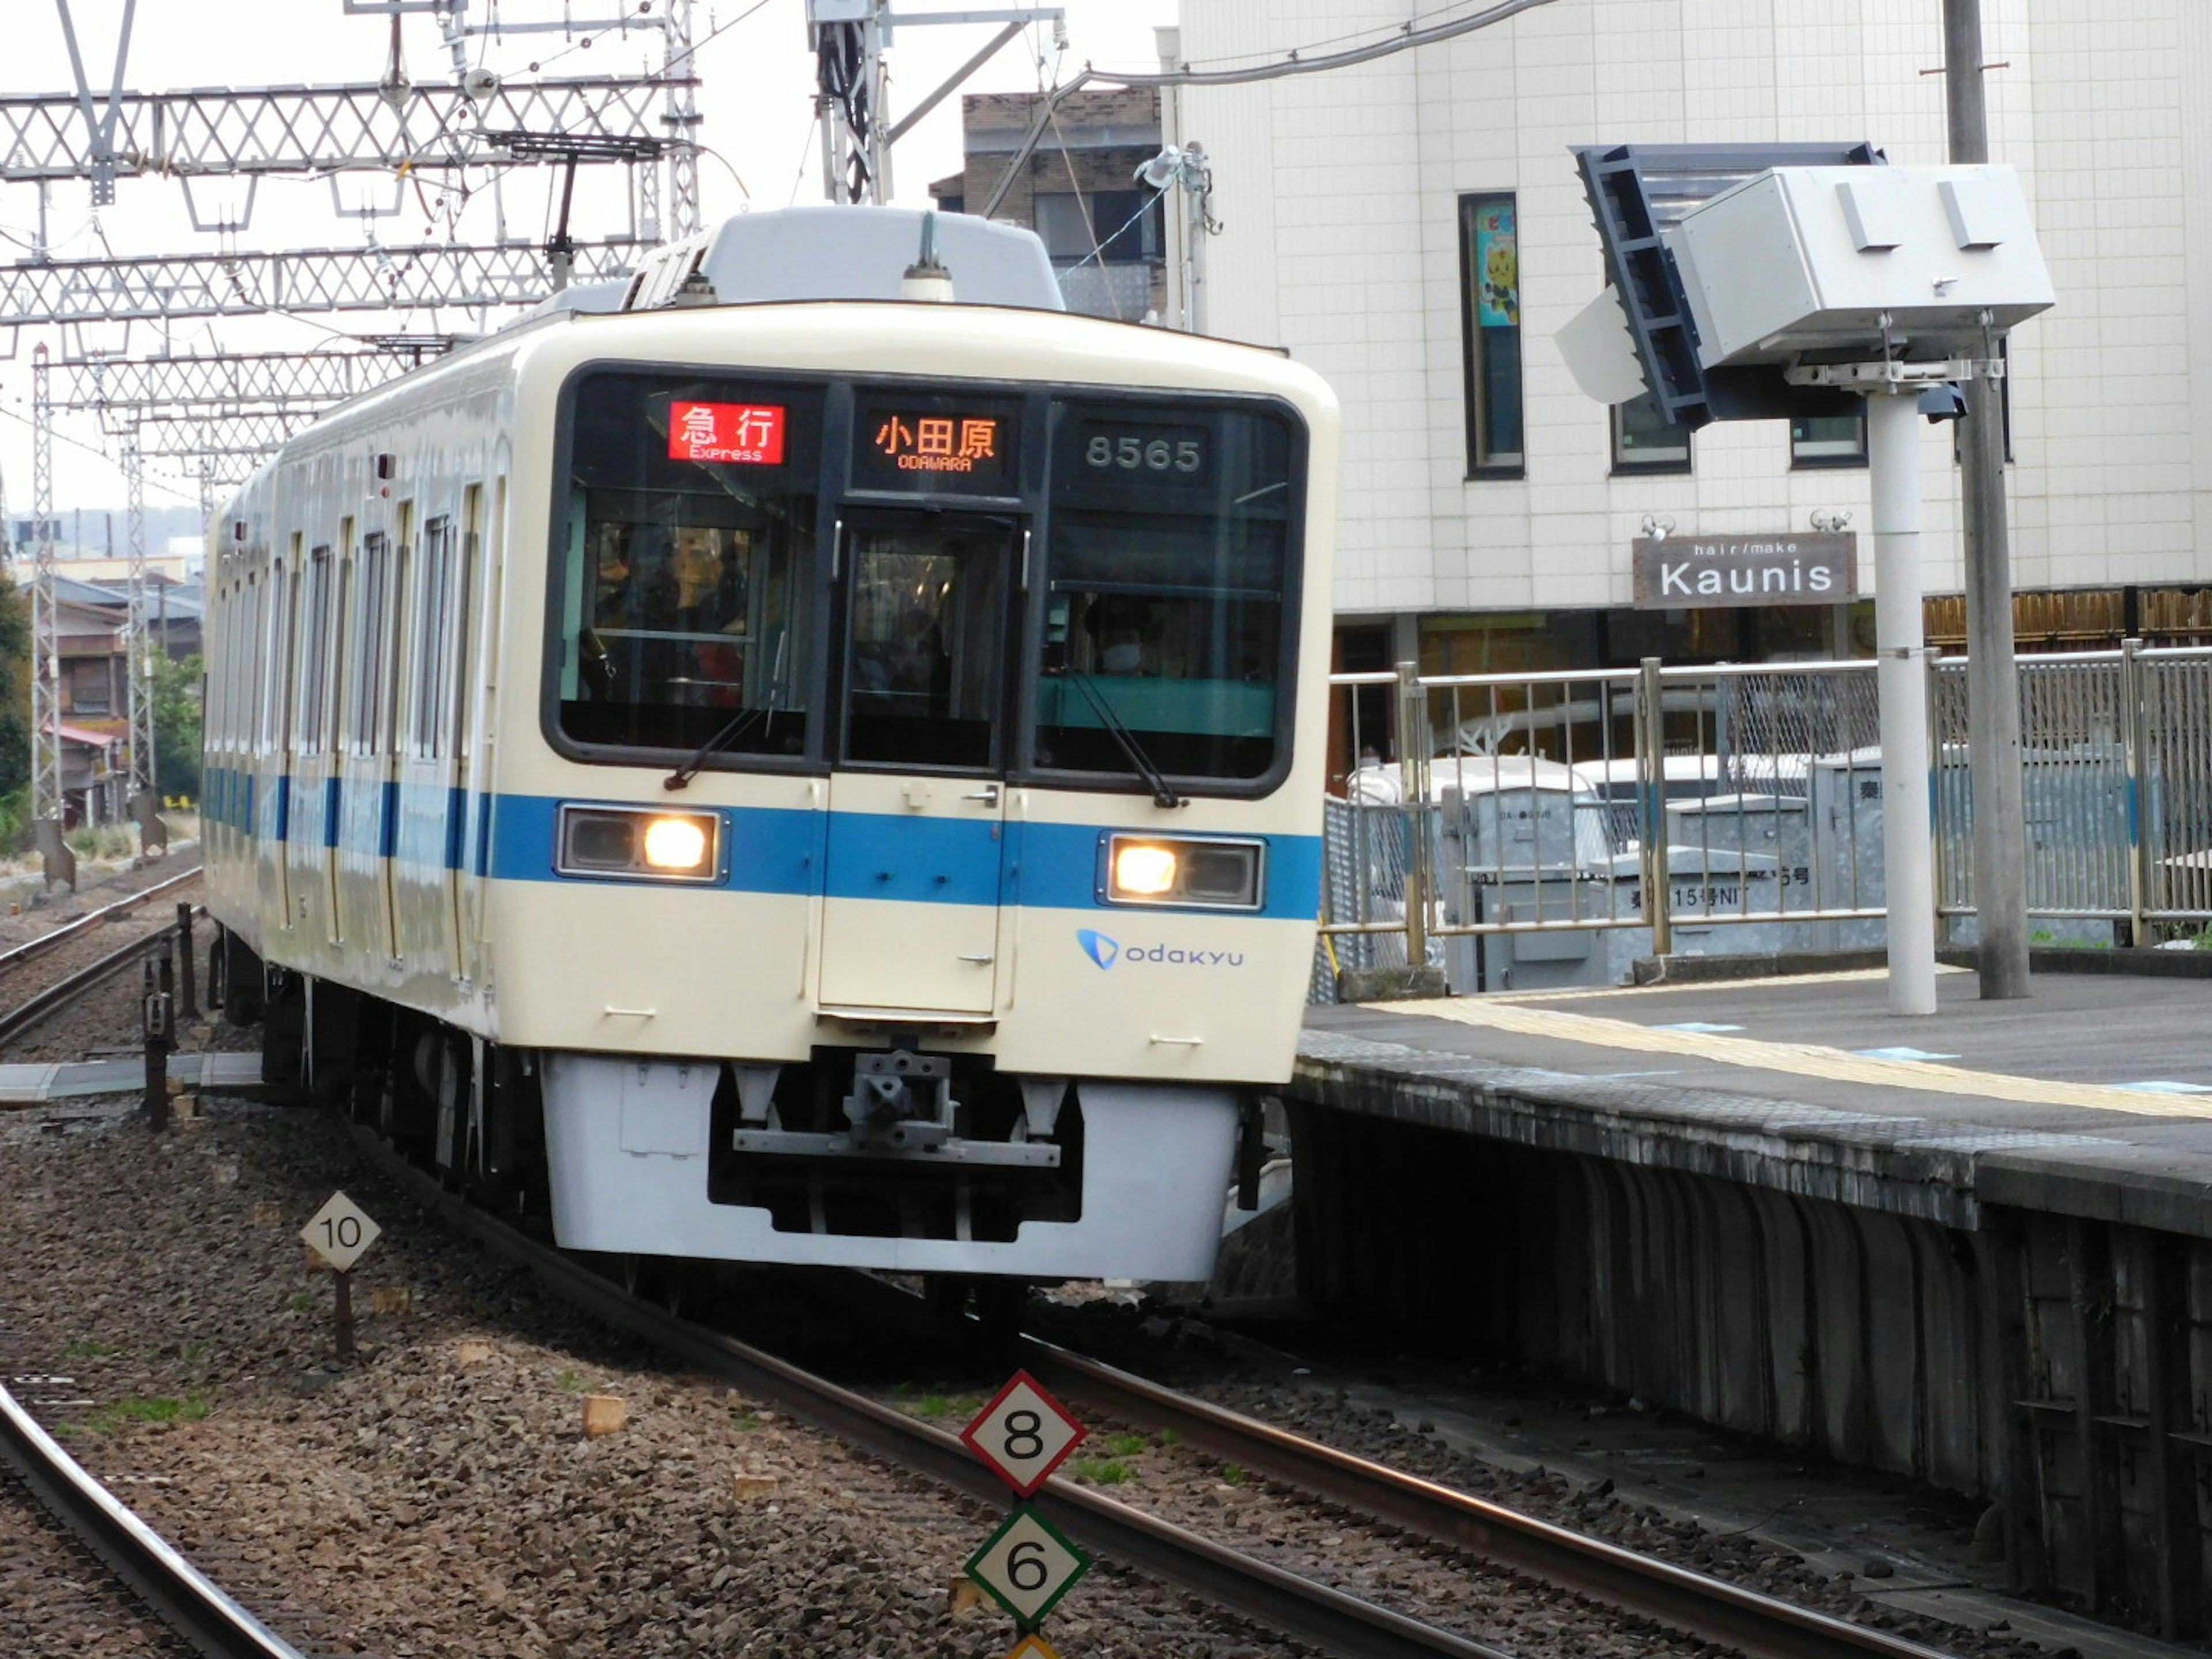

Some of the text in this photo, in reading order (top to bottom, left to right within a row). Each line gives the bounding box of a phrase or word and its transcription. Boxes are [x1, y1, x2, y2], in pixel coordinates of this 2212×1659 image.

[680, 406, 773, 447] 急行
[875, 415, 997, 459] 小田原
[690, 445, 763, 461] Express
[897, 454, 972, 472] ODAWARA
[1086, 437, 1199, 472] 8565
[1661, 559, 1832, 596] Kaunis
[1126, 944, 1243, 967] odakyu
[320, 1217, 361, 1249] 10
[1005, 1410, 1043, 1459] 8
[1007, 1541, 1047, 1590] 6
